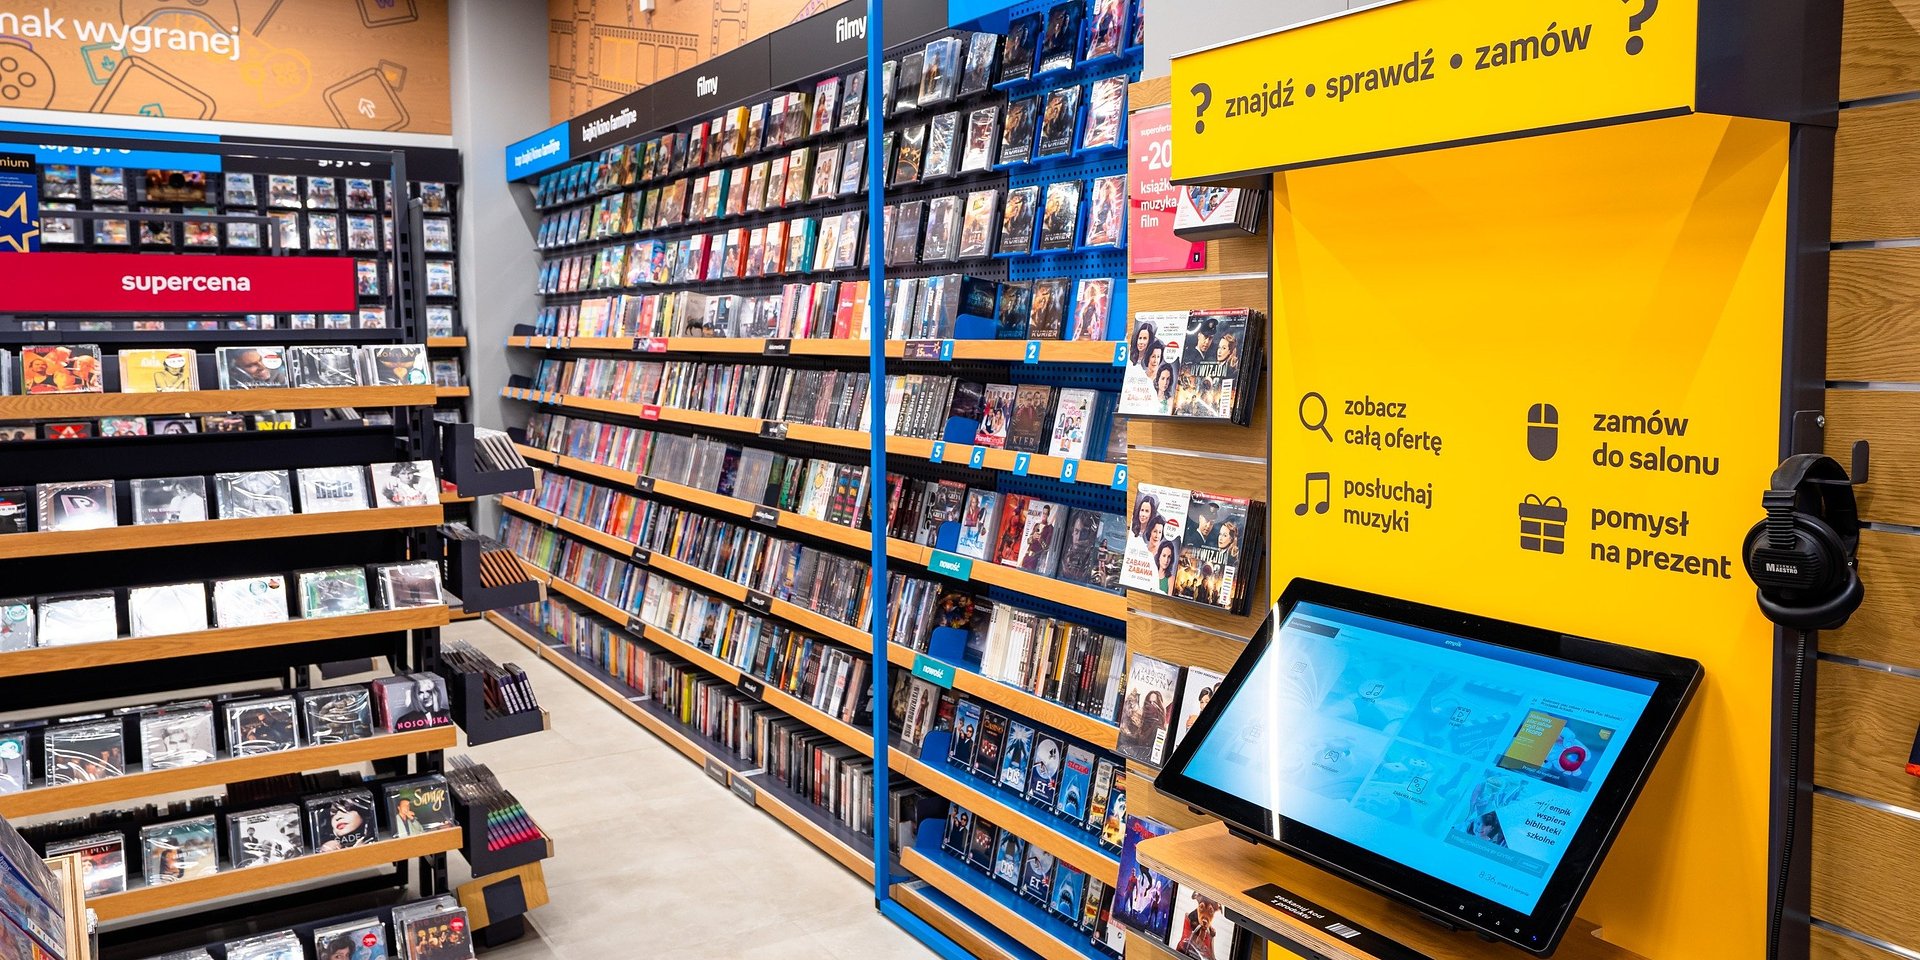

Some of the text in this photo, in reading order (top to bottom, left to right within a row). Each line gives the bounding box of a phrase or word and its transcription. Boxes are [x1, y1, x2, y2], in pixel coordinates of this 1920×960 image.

[836, 15, 867, 44] filmy
[73, 18, 240, 61] wygranej
[1225, 78, 1295, 119] znajdź
[1326, 47, 1435, 103] sprawdź
[1474, 21, 1593, 71] zamów
[696, 75, 719, 97] filmy
[1140, 215, 1159, 228] film
[121, 274, 251, 295] supercena
[943, 343, 950, 357] 1
[1028, 344, 1037, 359] 2
[1118, 345, 1126, 362] 3
[904, 395, 916, 432] SHERLOCK
[913, 391, 926, 429] SHERLOCK
[921, 391, 934, 429] SHERLOCK
[1344, 395, 1407, 419] zobacz
[1592, 410, 1689, 438] zamów
[1344, 426, 1443, 457] całą ofertę
[934, 445, 941, 458] 5
[973, 451, 981, 464] 6
[1591, 441, 1721, 477] do salonu
[1019, 456, 1027, 471] 7
[1064, 463, 1073, 478] 8
[1117, 470, 1126, 485] 9
[1343, 476, 1433, 510] posłuchaj
[1343, 507, 1410, 534] muzyki
[1591, 507, 1690, 539] pomysł
[939, 558, 961, 572] nowość
[1126, 557, 1151, 569] ZABAWA
[1590, 541, 1733, 580] na prezent
[1765, 563, 1798, 575] MAESTRO
[1128, 567, 1153, 577] ZABAWA
[1445, 640, 1463, 648] empik
[922, 665, 944, 679] nowość
[1131, 670, 1173, 691] MASZYNY
[397, 715, 450, 730] NOSOWSKA
[413, 788, 446, 812] Savage
[1536, 811, 1567, 827] wspiera
[1549, 804, 1572, 817] empik
[1524, 818, 1563, 836] biblioteki
[1526, 830, 1556, 846] szkolne
[1274, 894, 1326, 919] zeskanuj kod
[1275, 901, 1312, 920] produktu
